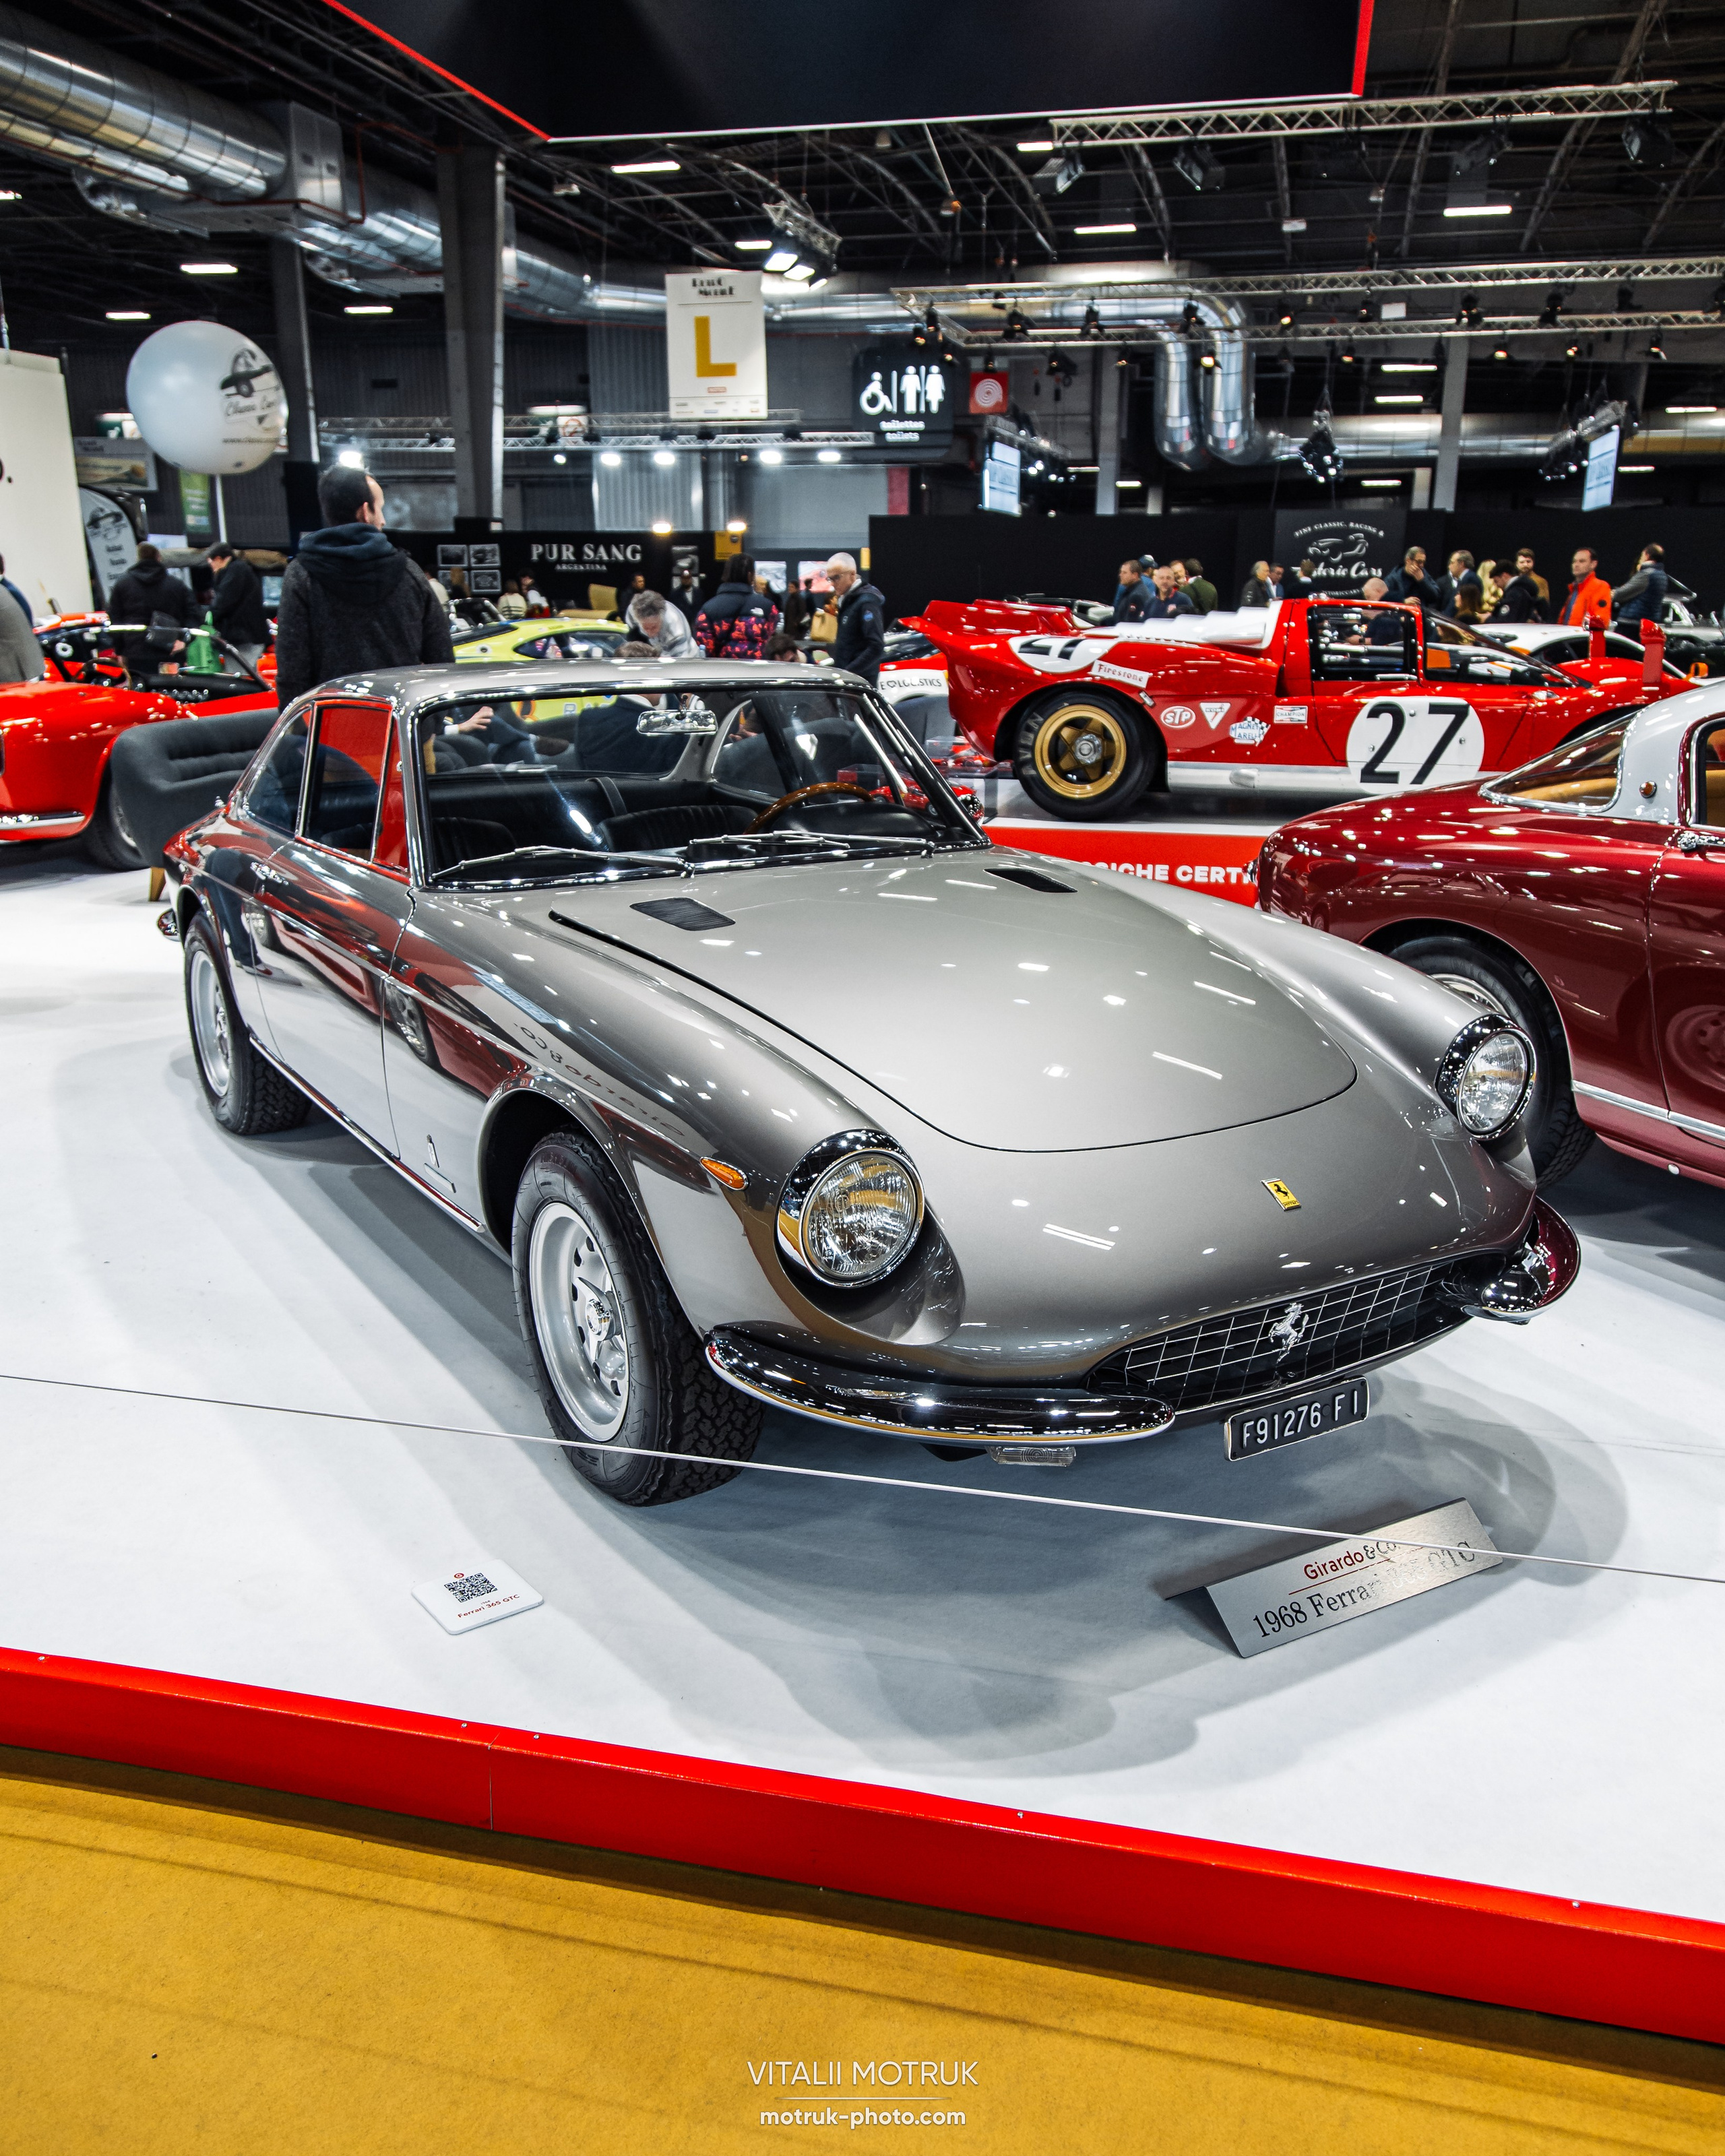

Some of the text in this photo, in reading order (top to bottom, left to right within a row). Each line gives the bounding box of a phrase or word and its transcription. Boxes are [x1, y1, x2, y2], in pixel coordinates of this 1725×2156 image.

[694, 315, 737, 377] L
[879, 419, 926, 431] toilettes
[885, 431, 920, 442] toilets
[1348, 521, 1377, 533] RACING
[530, 543, 641, 561] PUR SANG
[1350, 561, 1383, 578] Cars
[1097, 663, 1144, 682] Firestone
[1164, 708, 1191, 724] STP
[1360, 701, 1470, 785] 27
[1243, 1402, 1321, 1449] F91276
[458, 1606, 485, 1618] Ferrari
[502, 1594, 520, 1602] GTC
[1253, 1601, 1308, 1638] 1968
